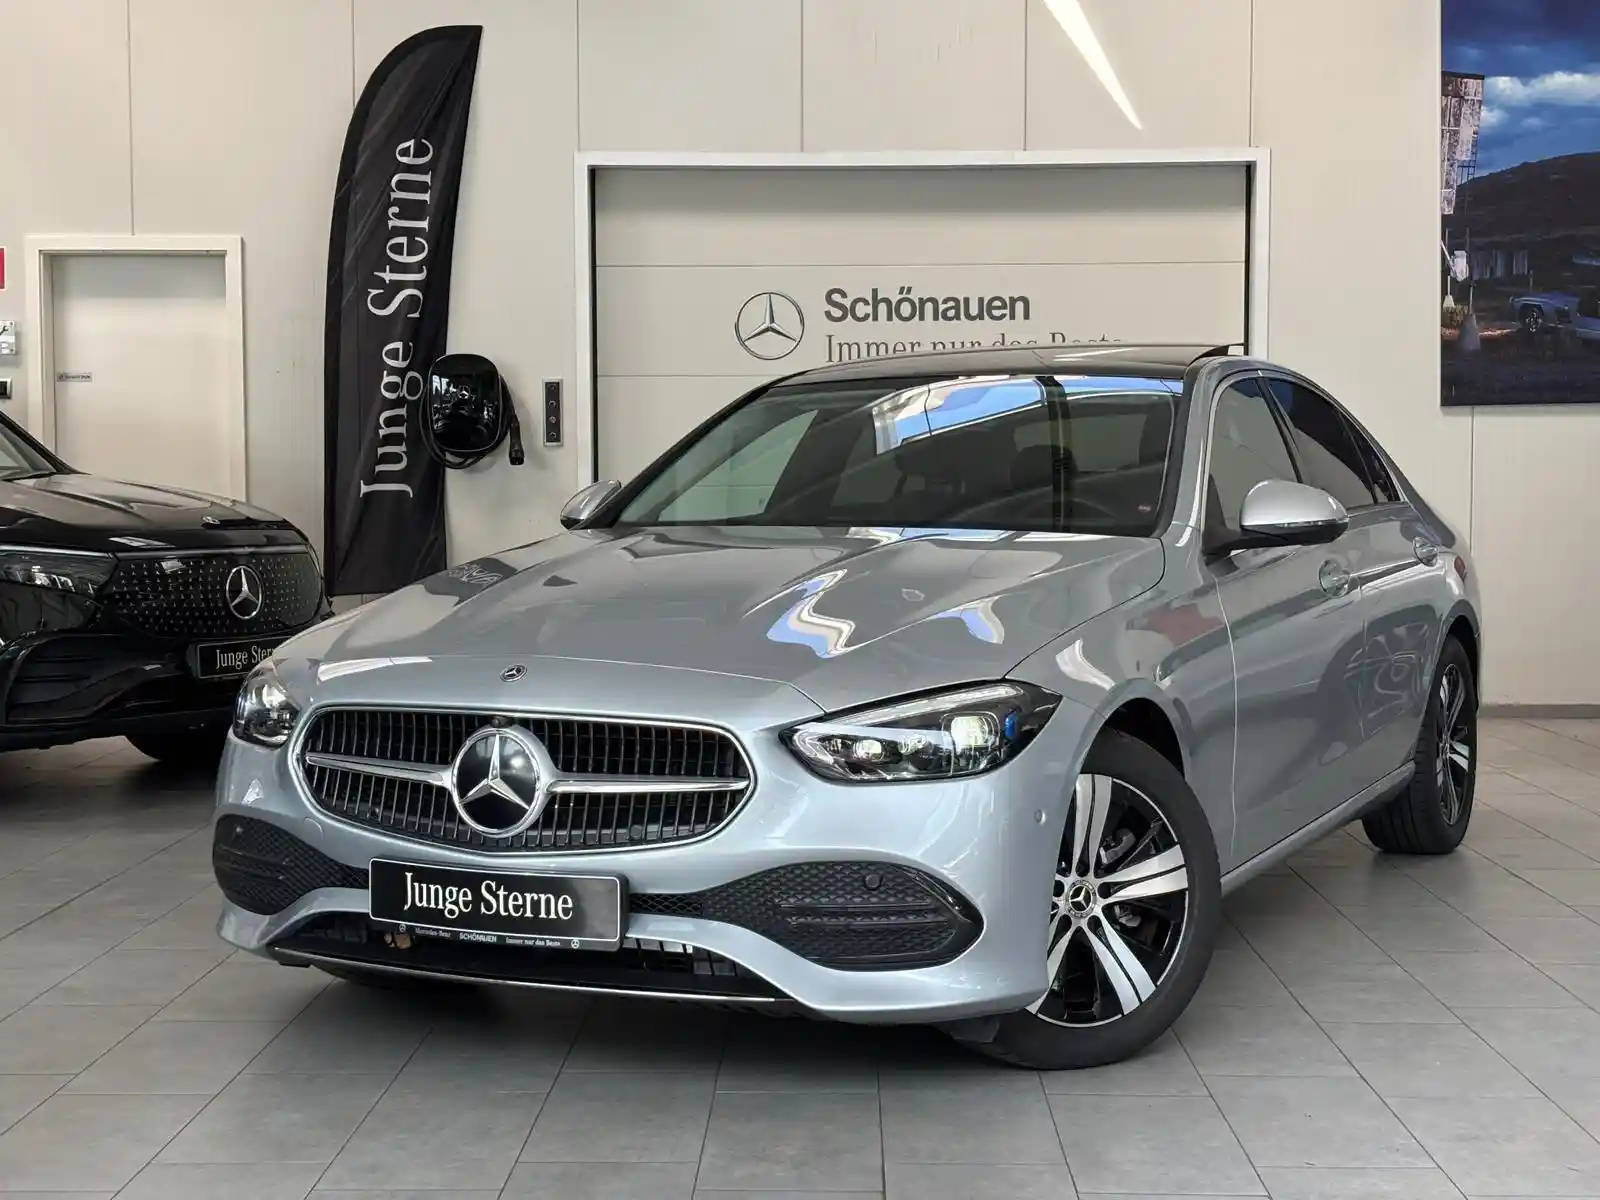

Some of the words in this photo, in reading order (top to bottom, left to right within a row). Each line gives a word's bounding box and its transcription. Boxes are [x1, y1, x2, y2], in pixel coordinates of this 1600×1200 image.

[367, 137, 434, 318] Sterne
[824, 286, 1030, 323] Schönauen
[825, 334, 921, 362] Immer
[360, 340, 424, 498] Junge
[216, 649, 248, 670] Junge
[251, 645, 275, 664] Ster
[403, 871, 473, 919] Junge
[480, 880, 574, 920] Sterne
